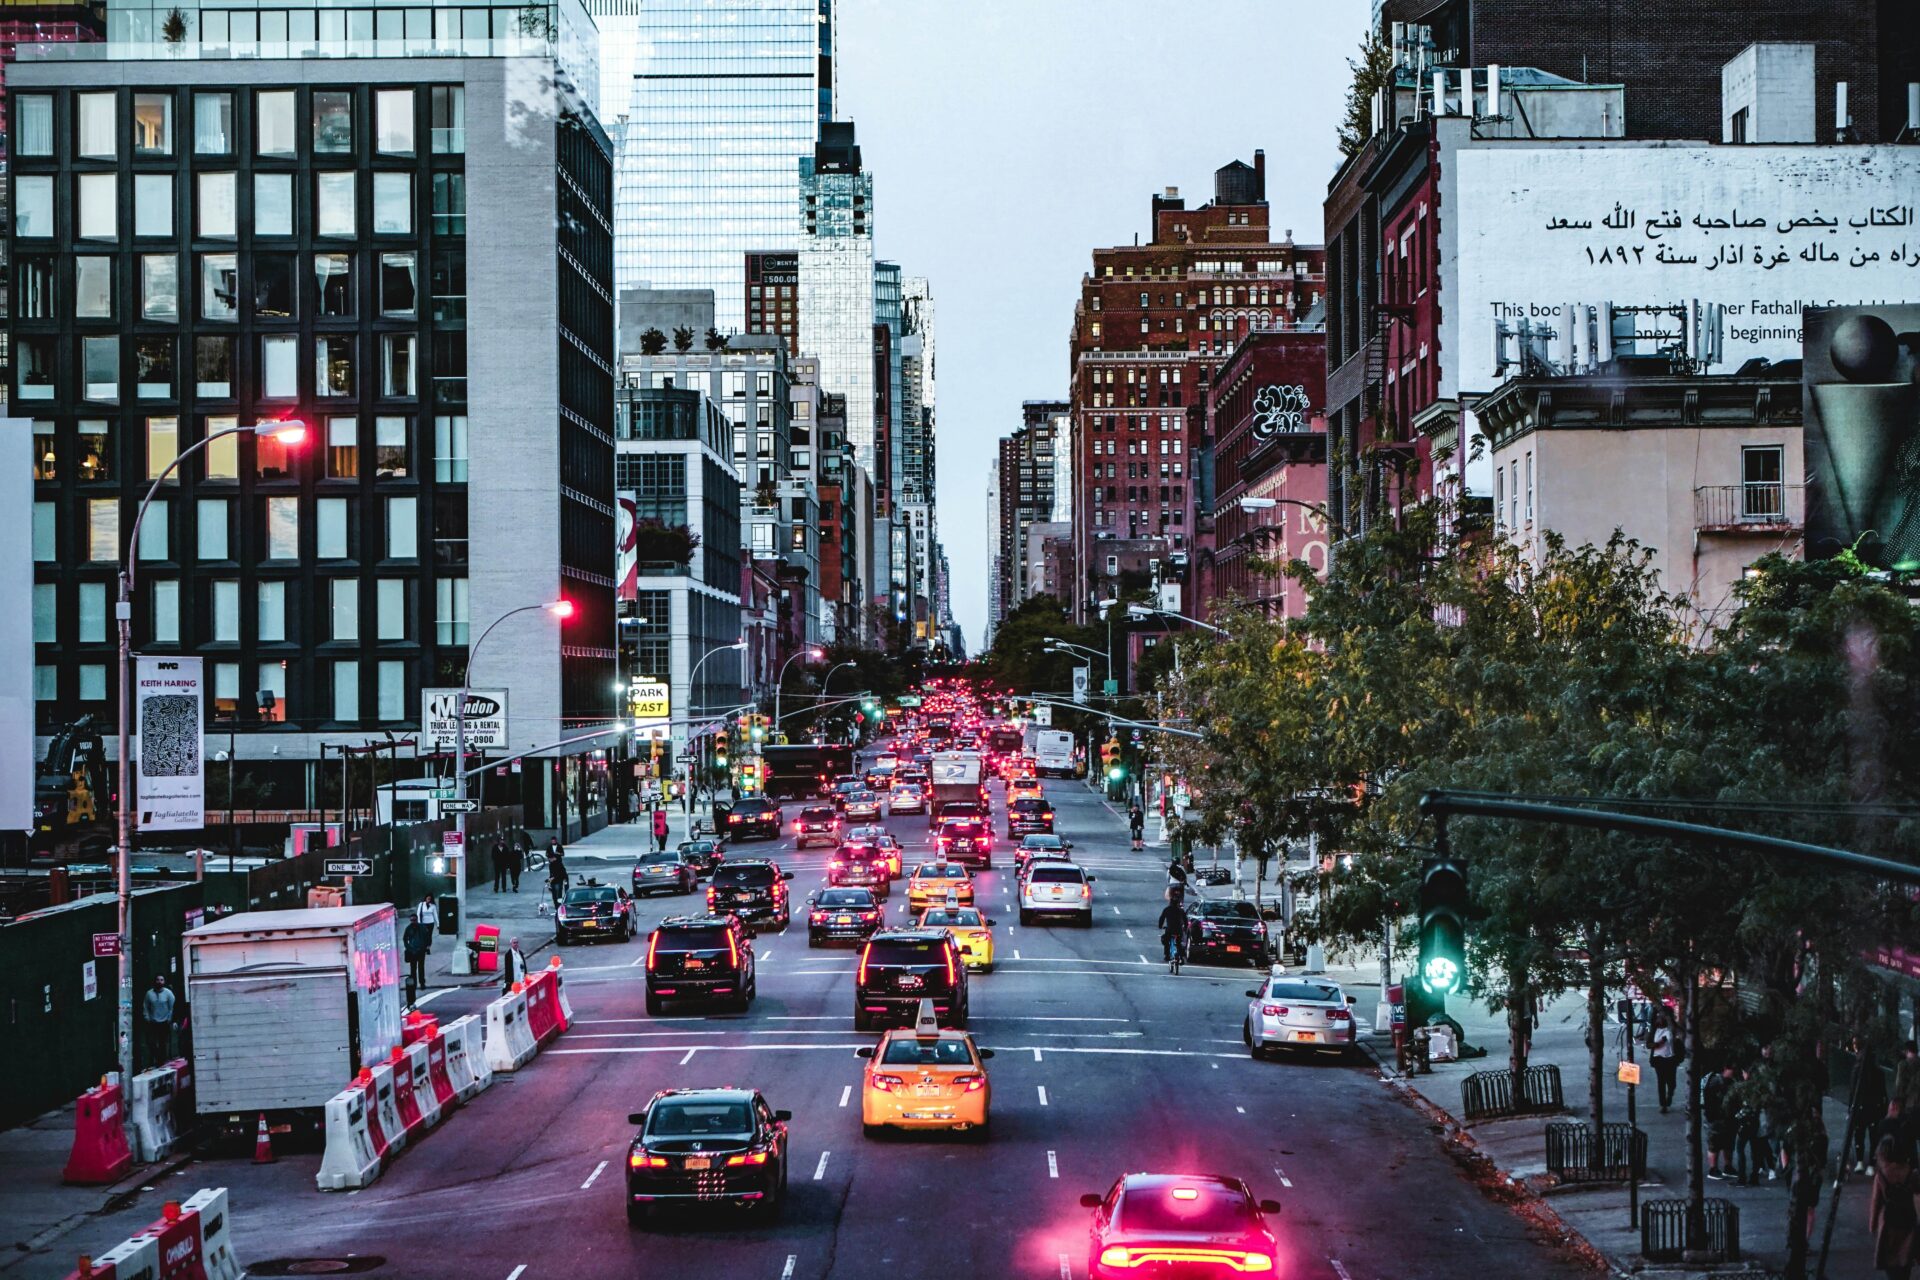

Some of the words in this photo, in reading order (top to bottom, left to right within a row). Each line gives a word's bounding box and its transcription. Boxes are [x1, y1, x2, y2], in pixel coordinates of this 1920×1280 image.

[1546, 216, 1592, 230] سعد
[1645, 209, 1682, 239] فتح
[1692, 208, 1767, 235] صاحبه
[1777, 209, 1838, 234] يخص
[1849, 205, 1913, 235] الكتاب
[1585, 246, 1645, 266] ١٨٩٢
[1655, 243, 1697, 264] سنة
[1705, 243, 1743, 270] اذار
[1753, 244, 1790, 270] غرة
[1799, 241, 1840, 262] ماله
[1850, 246, 1880, 267] من
[768, 275, 798, 283] 500.08
[1490, 301, 1524, 317] This
[1530, 301, 1567, 317] boo
[1634, 329, 1672, 345] oney
[1730, 324, 1804, 345] beginning
[158, 662, 179, 670] NYC
[633, 688, 664, 697] PARK
[434, 694, 495, 721] Mndon
[635, 702, 664, 712] FAST
[430, 721, 448, 730] TRUCK
[449, 721, 472, 730] LEANG
[474, 721, 478, 729] &
[480, 721, 500, 729] RENTAL
[437, 735, 494, 744] 212-5-0900
[440, 789, 448, 798] 18
